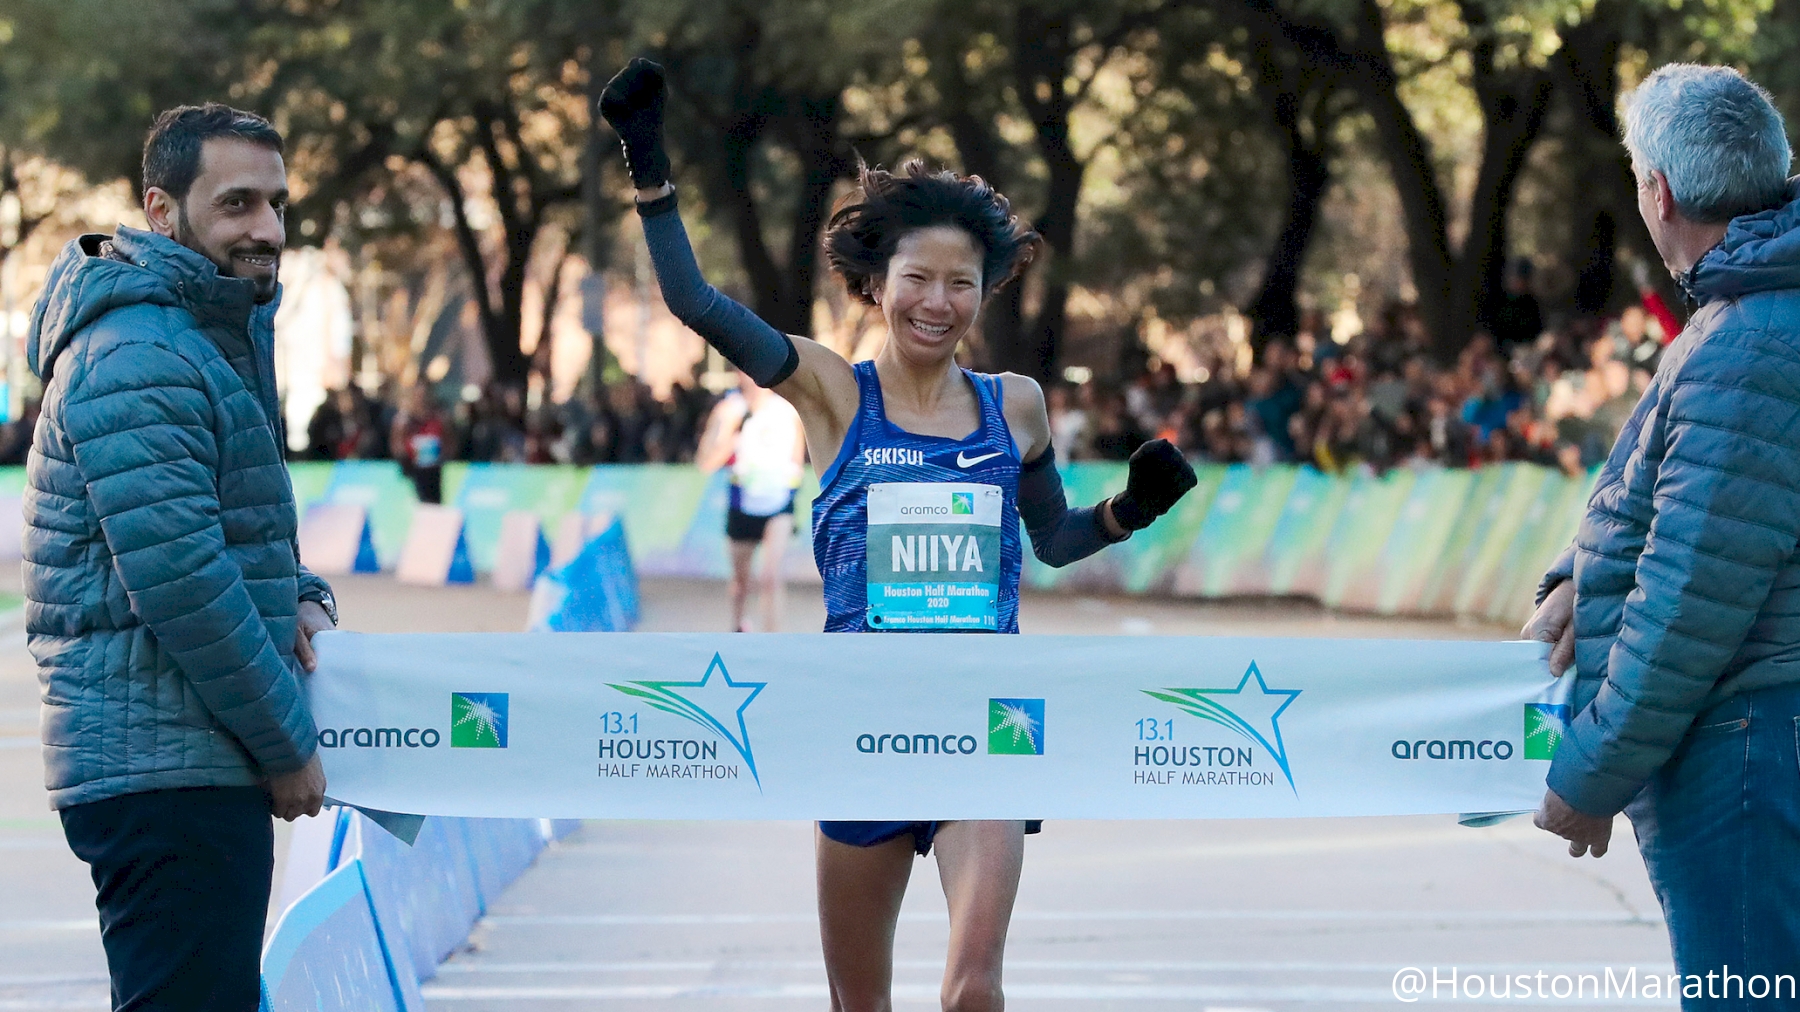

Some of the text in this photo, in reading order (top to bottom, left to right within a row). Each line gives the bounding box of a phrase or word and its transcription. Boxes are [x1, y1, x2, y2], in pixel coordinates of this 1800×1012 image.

[864, 448, 923, 466] SEKISUI
[900, 504, 948, 515] aramco
[891, 535, 984, 573] NIIYA
[884, 585, 989, 597] Houston Half Marathon
[927, 597, 949, 608] 2020
[907, 615, 933, 624] Houston
[934, 615, 949, 624] Half
[950, 615, 980, 624] Marathon
[600, 711, 638, 734] 13.1
[1135, 717, 1173, 741] 13.1
[319, 728, 440, 748] aramco
[856, 733, 978, 755] aramco
[598, 739, 717, 760] HOUSTON
[1134, 746, 1252, 767] HOUSTON
[1391, 739, 1514, 761] aramco
[598, 763, 738, 779] HALF MARATHON
[1134, 770, 1274, 786] HALF MARATHON
